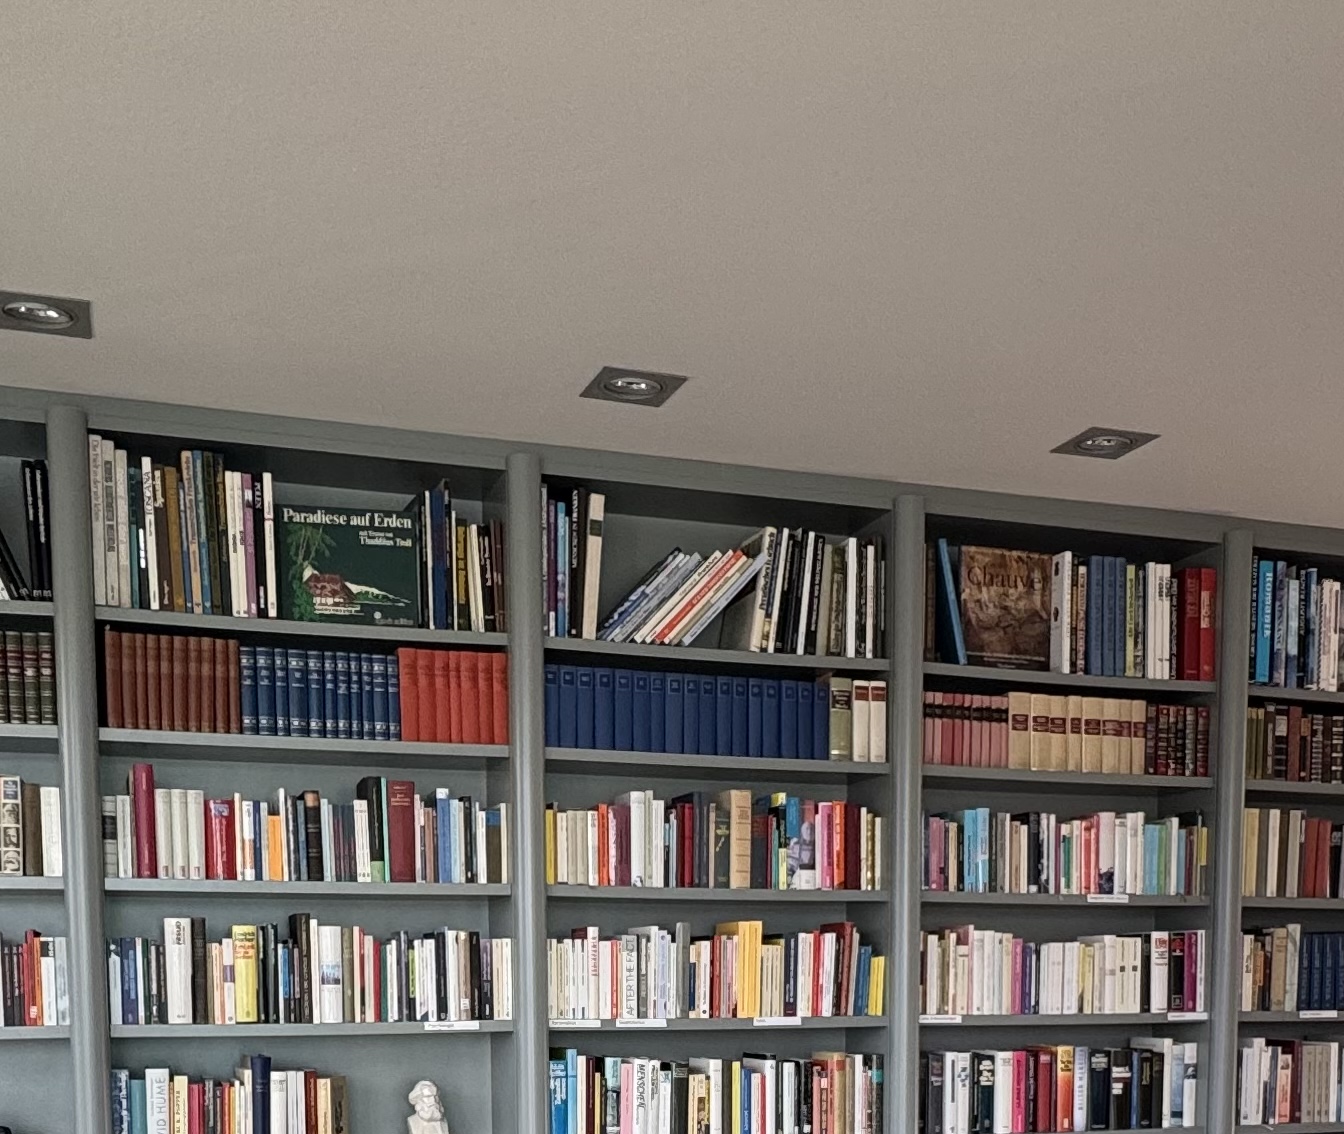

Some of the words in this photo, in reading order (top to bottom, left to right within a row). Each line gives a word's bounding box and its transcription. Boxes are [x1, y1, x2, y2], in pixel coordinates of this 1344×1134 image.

[283, 508, 348, 525] Paradiese
[350, 513, 371, 526] auf
[374, 513, 412, 528] Erden
[625, 938, 634, 962] FACT
[626, 965, 634, 983] THE
[625, 984, 634, 1016] AFTER
[155, 1077, 167, 1114] HUME
